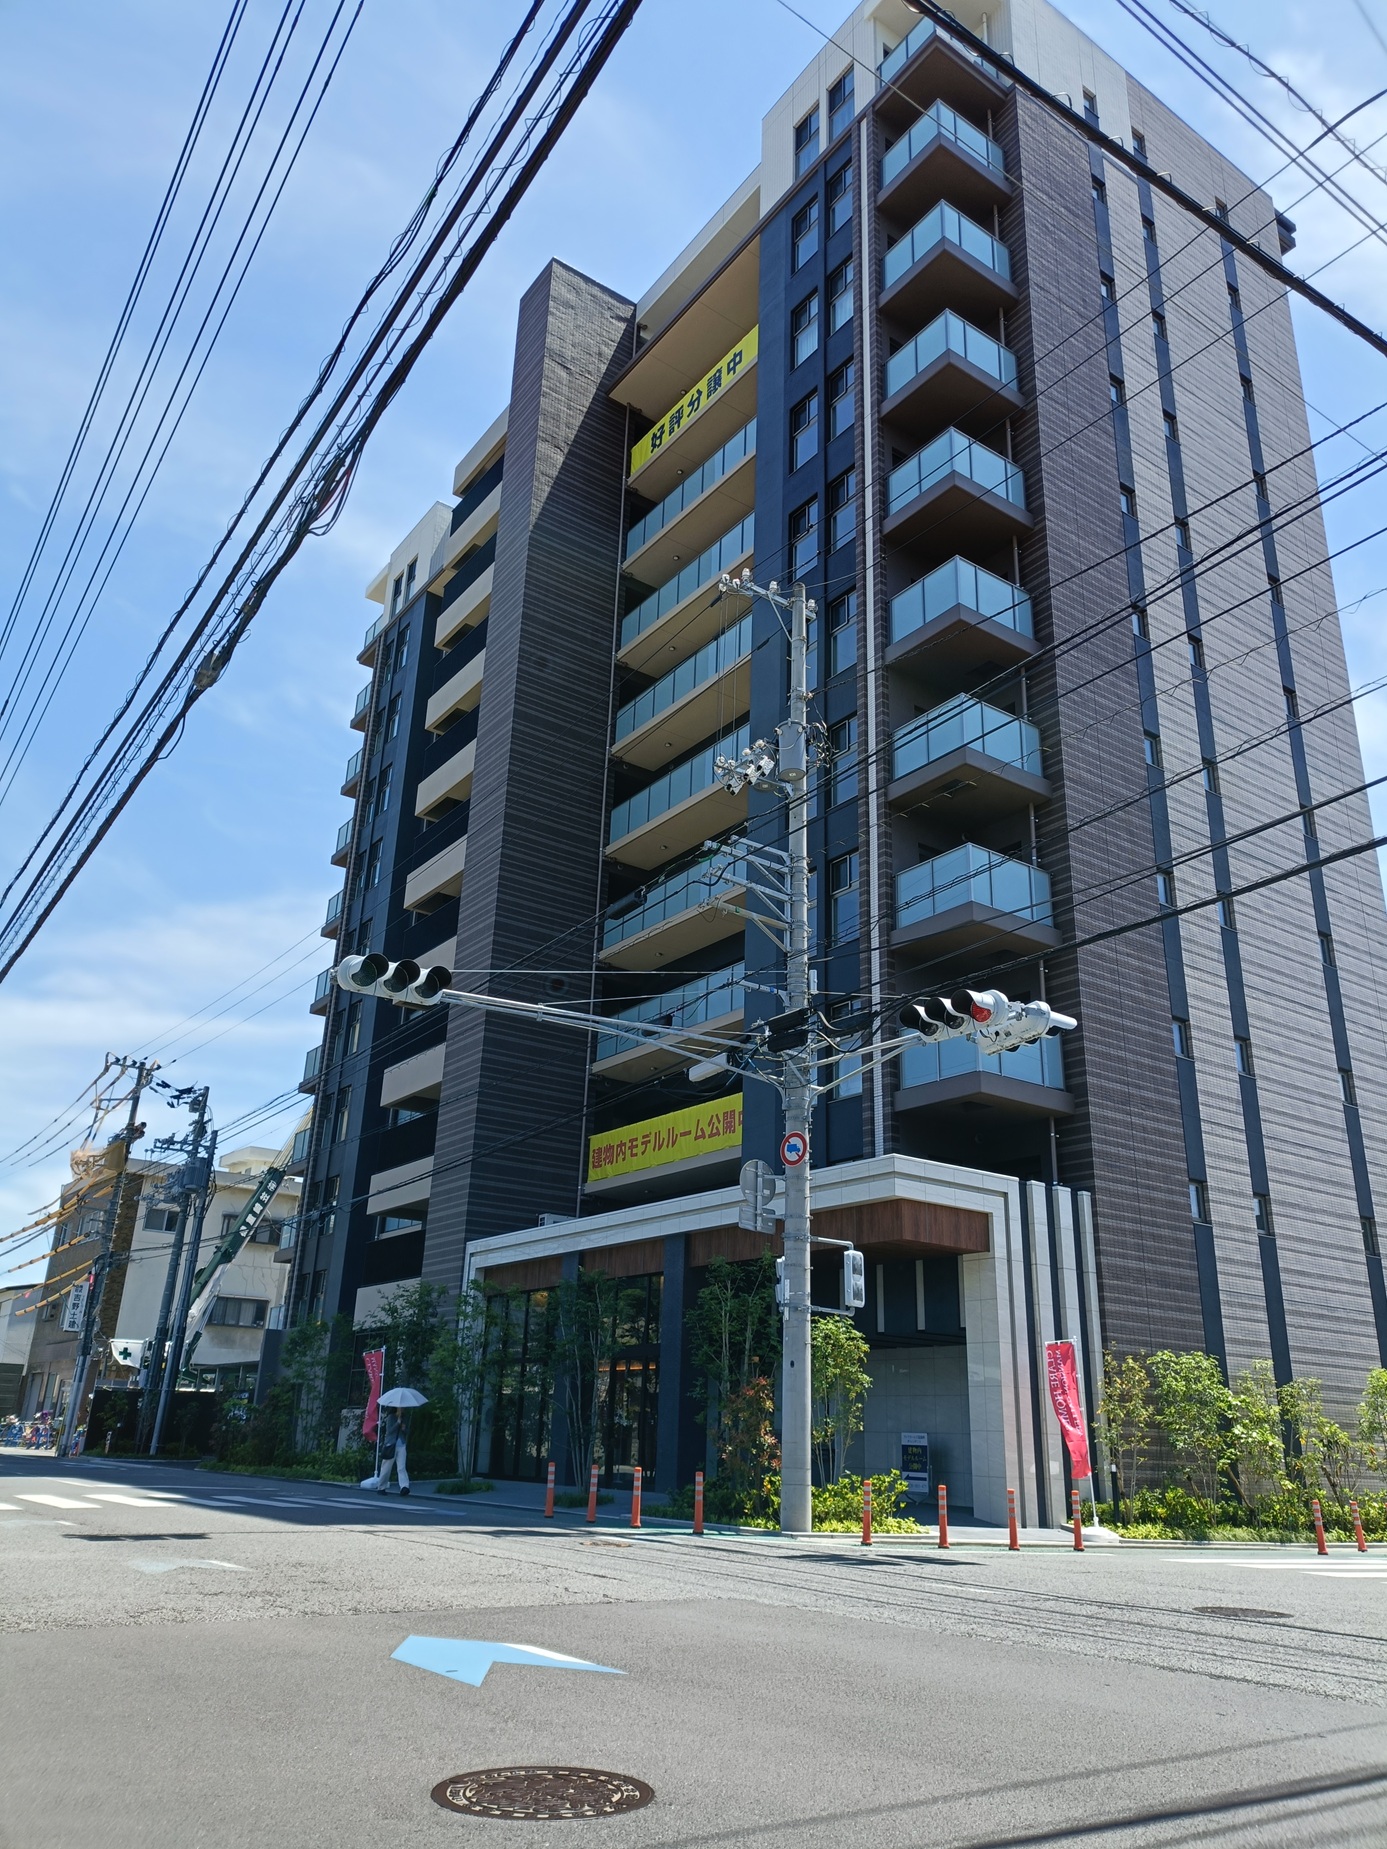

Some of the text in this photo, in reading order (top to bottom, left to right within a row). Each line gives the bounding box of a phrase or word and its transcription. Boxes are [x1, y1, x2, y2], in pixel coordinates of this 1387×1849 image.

[650, 349, 743, 453] 好評分譲中
